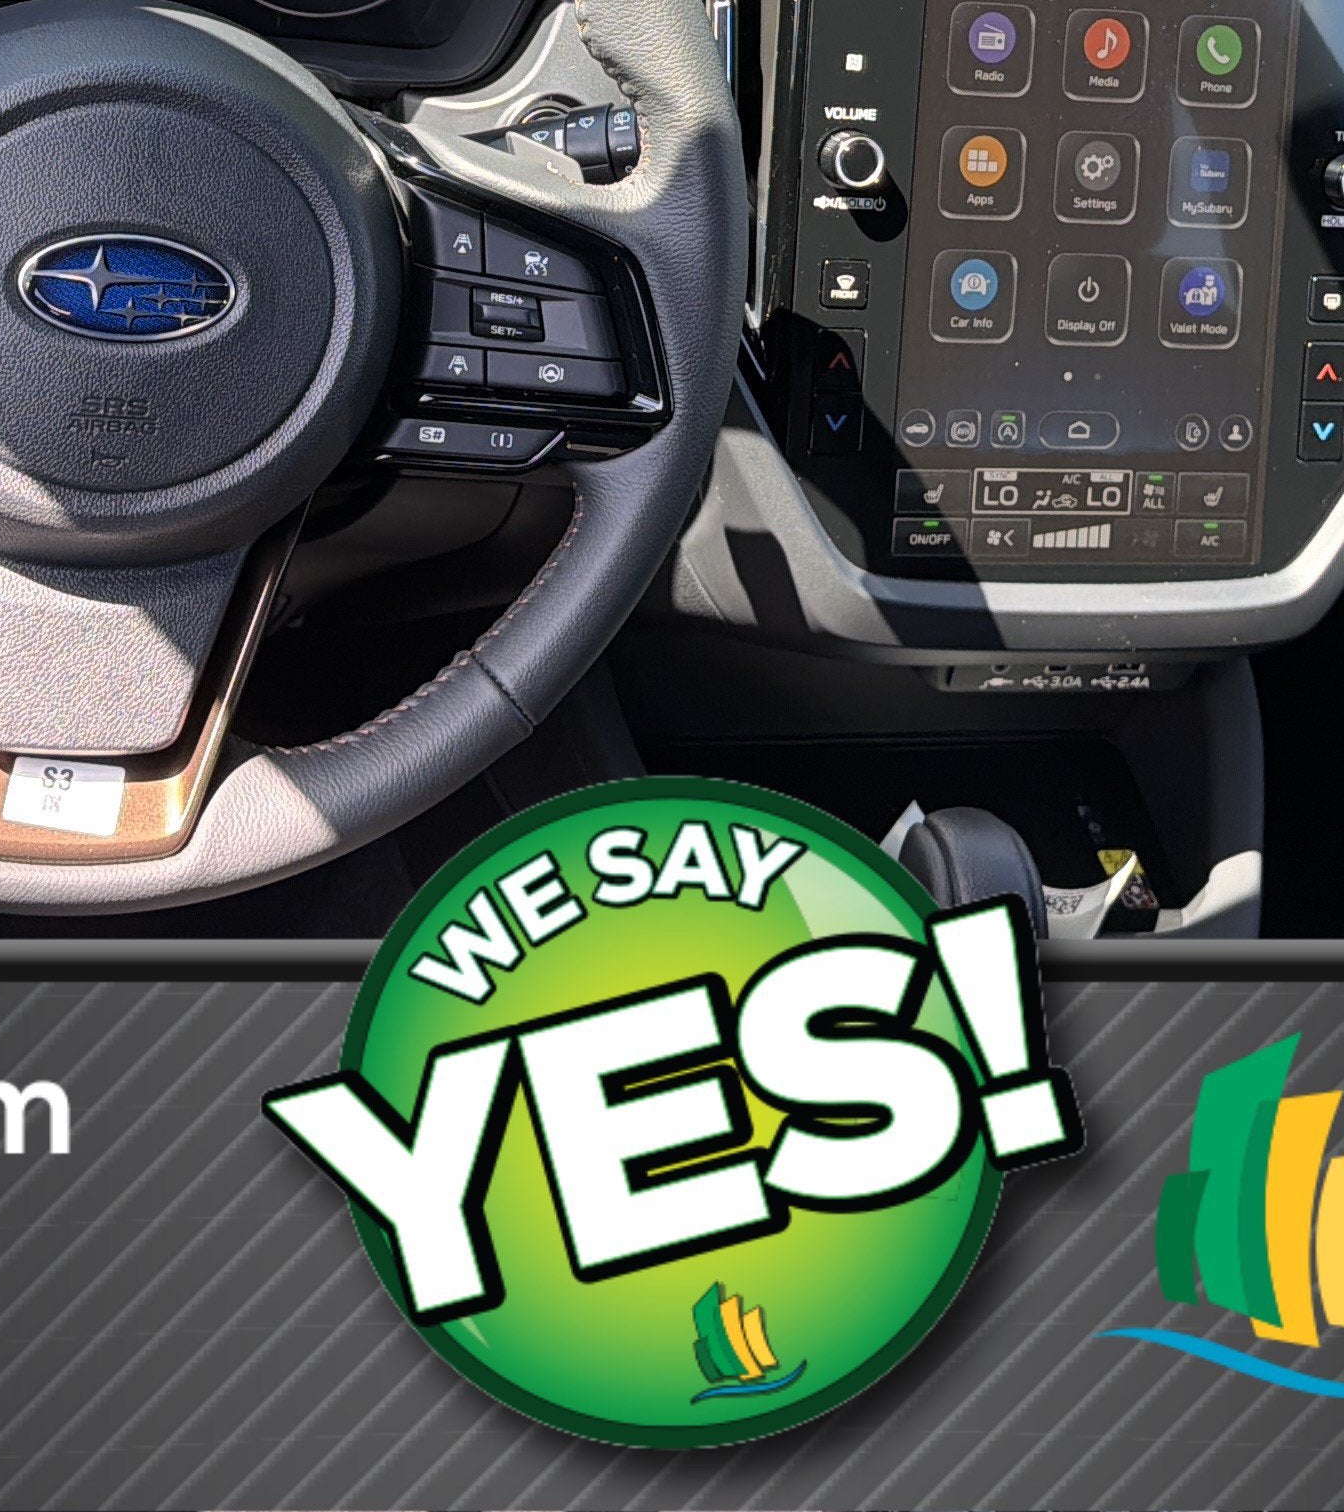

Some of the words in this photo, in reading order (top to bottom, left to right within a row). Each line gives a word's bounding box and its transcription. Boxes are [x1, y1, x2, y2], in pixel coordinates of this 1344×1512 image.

[975, 70, 1004, 82] Radio
[1088, 75, 1119, 88] Media
[1200, 81, 1232, 94] Phone
[824, 106, 877, 122] VOLUME
[966, 193, 994, 206] Apps
[1073, 197, 1117, 211] Settings
[1182, 202, 1233, 215] MySubaru
[490, 292, 524, 305] RES/+
[950, 317, 970, 328] Car
[973, 317, 993, 329] Info
[1057, 320, 1095, 333] Display
[1098, 320, 1116, 331] Off
[1170, 323, 1196, 334] Valet
[1200, 324, 1228, 335] Mode
[83, 396, 150, 417] SRS
[67, 418, 159, 434] AIRBAG
[1062, 474, 1081, 485] A/C
[983, 486, 1018, 506] LO
[1087, 486, 1121, 506] LO
[1143, 497, 1165, 510] ALL
[909, 533, 951, 546] ON/OFF
[1200, 535, 1219, 547] A/C
[1050, 676, 1082, 688] 3.0A
[1118, 676, 1150, 688] 2.4A
[42, 766, 74, 790] S3
